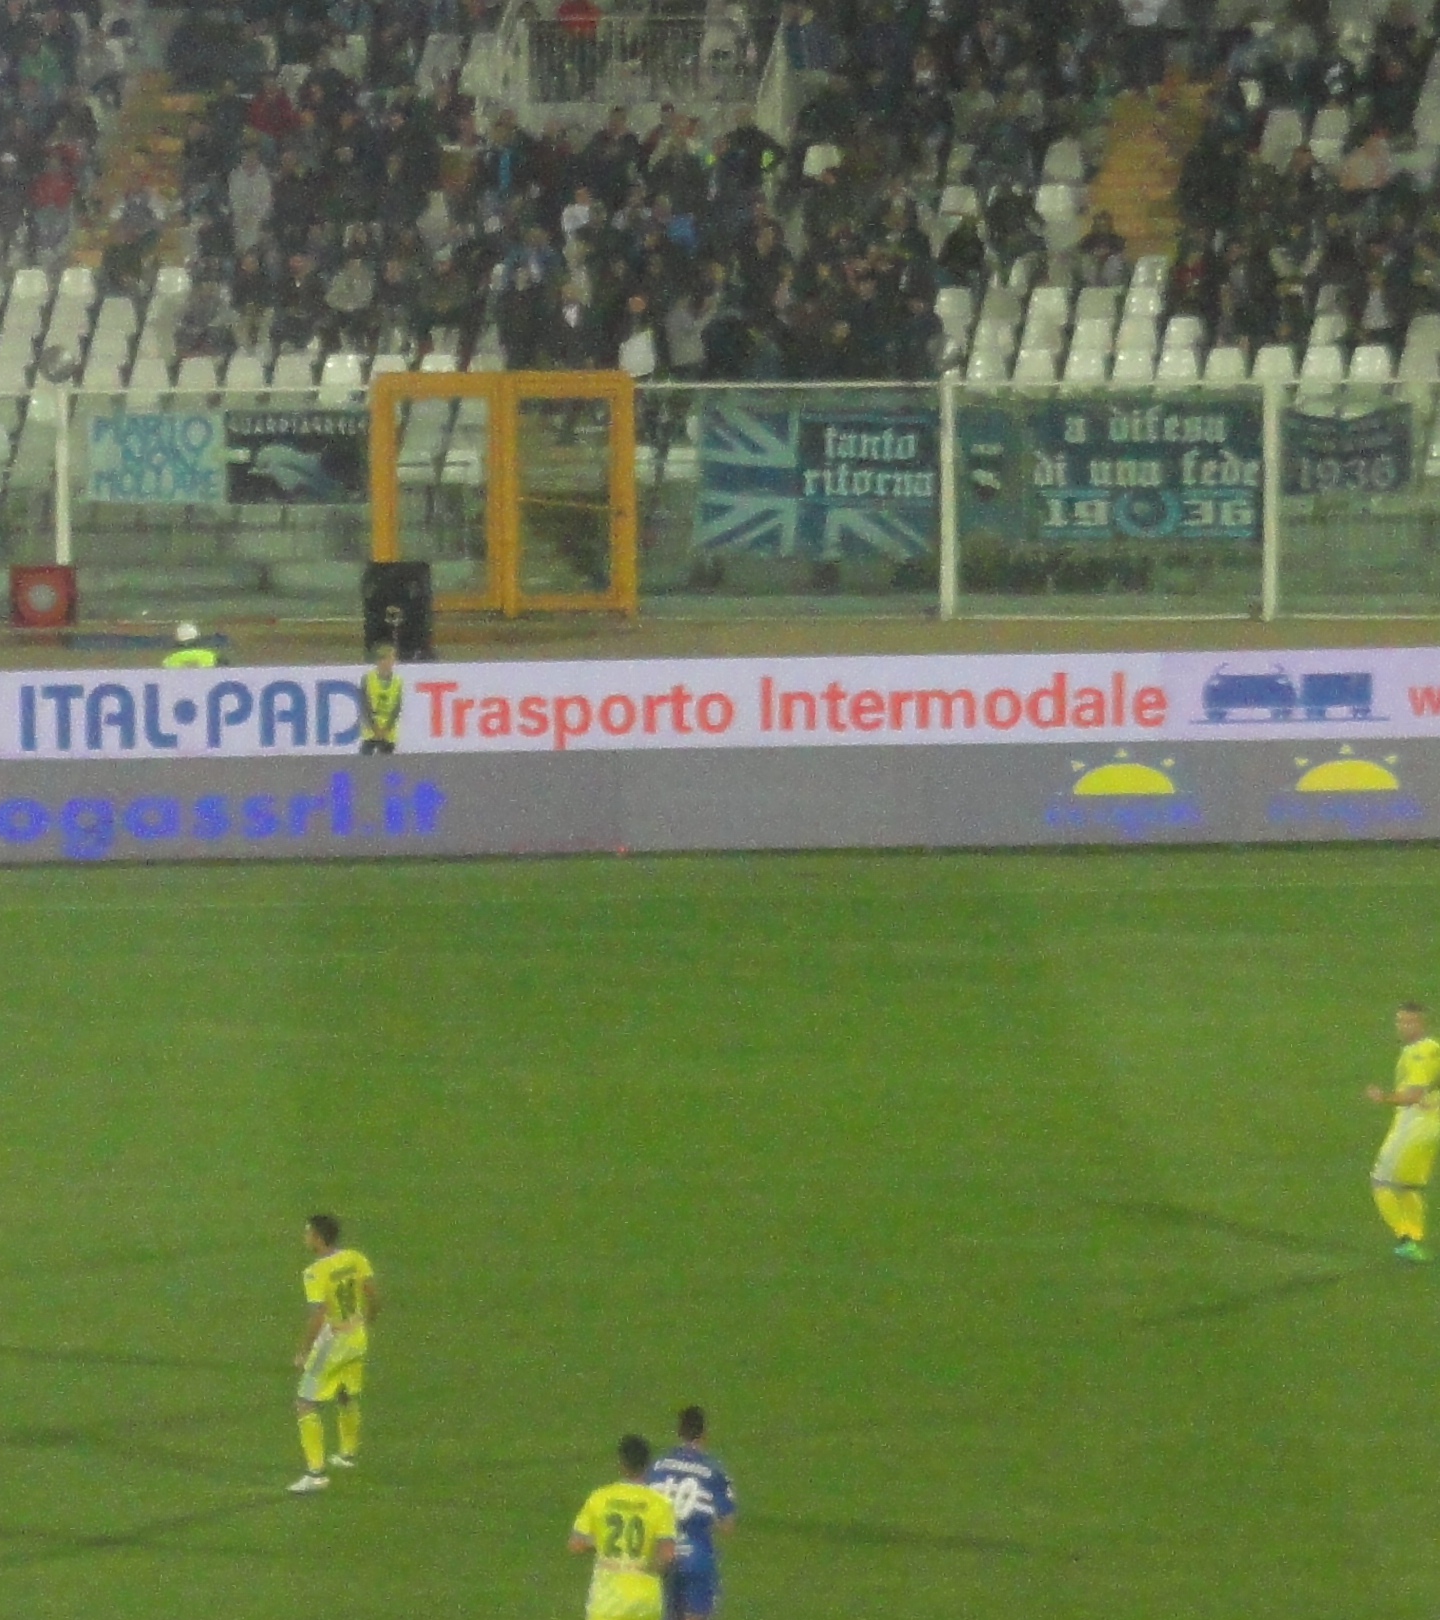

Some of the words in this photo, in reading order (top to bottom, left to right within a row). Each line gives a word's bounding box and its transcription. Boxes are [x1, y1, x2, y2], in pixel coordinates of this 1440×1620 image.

[414, 680, 733, 749] Trasporto
[759, 671, 1167, 733] Intermodale
[604, 1512, 646, 1559] 20
